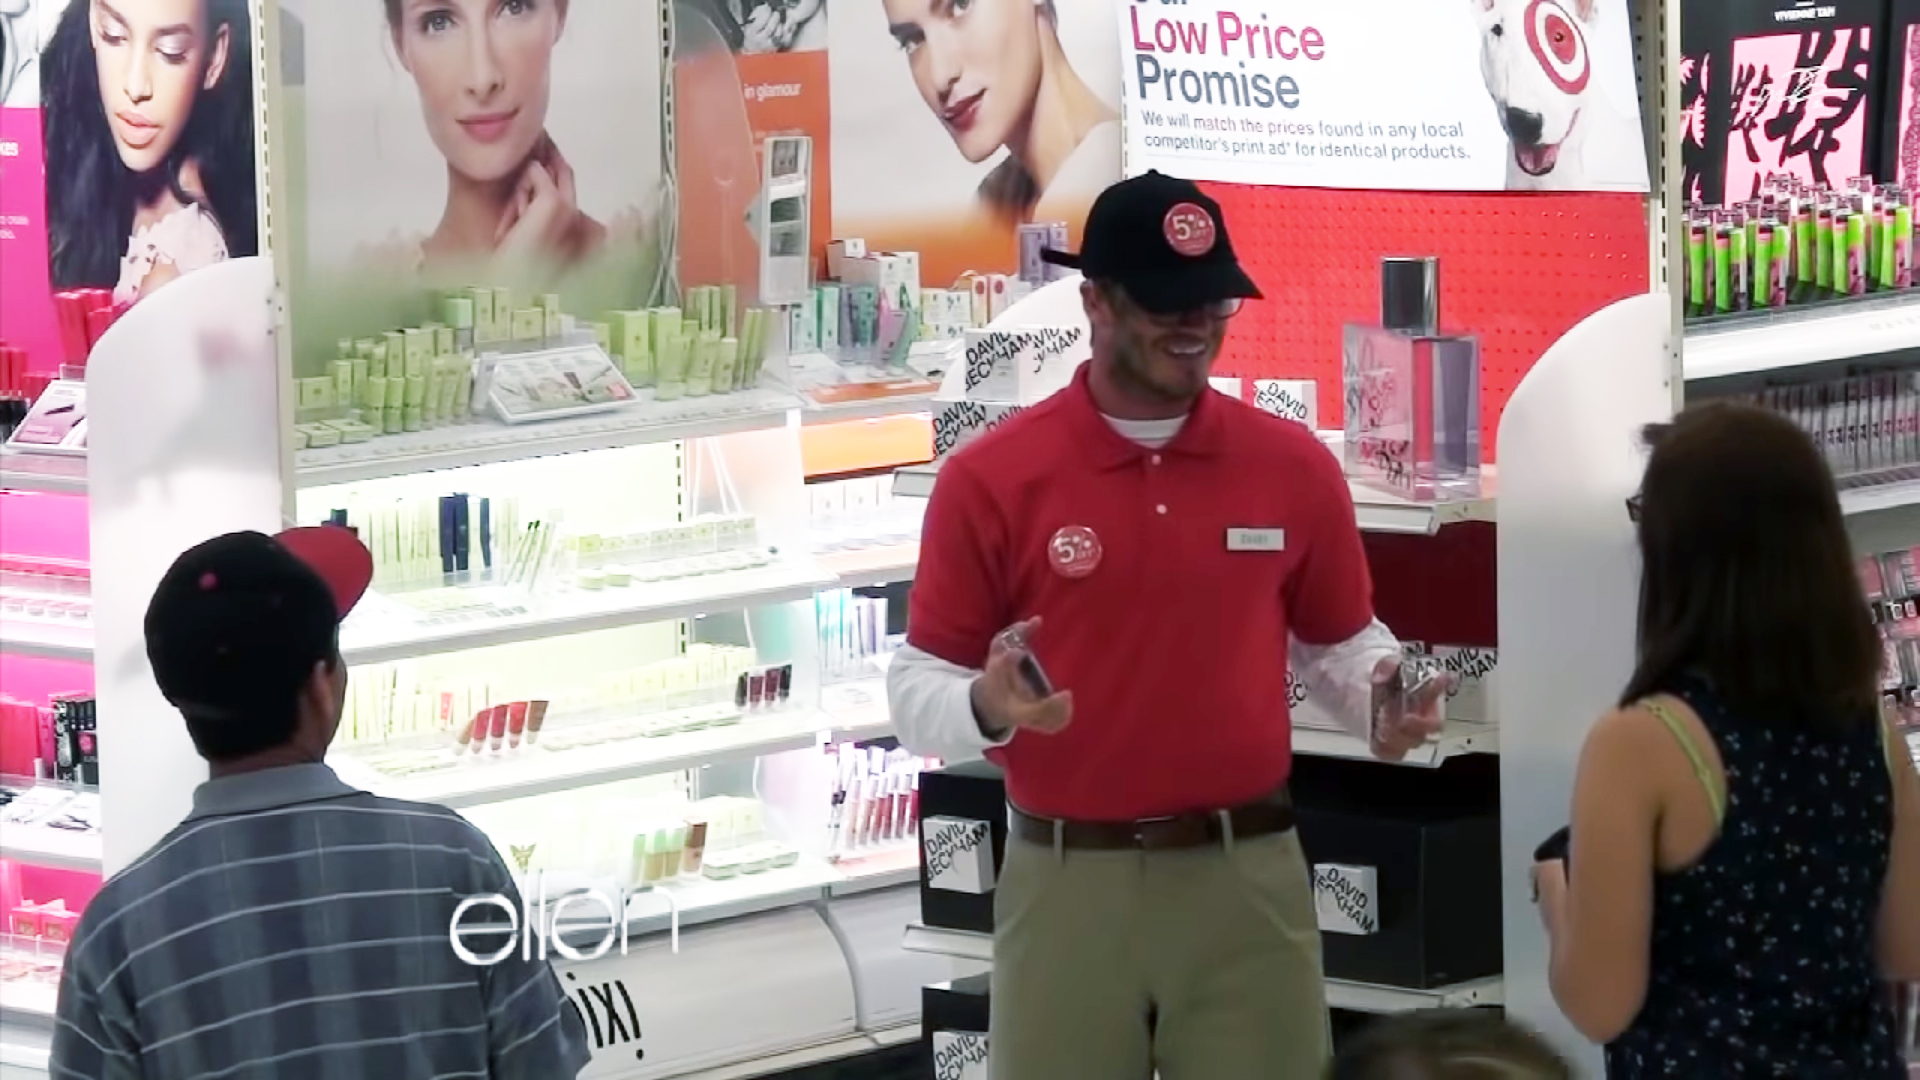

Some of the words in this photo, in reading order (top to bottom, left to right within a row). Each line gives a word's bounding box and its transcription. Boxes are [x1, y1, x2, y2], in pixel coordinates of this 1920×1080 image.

[1130, 5, 1208, 54] Low
[1216, 10, 1325, 61] Price
[1135, 53, 1300, 109] Promise
[1141, 110, 1163, 126] We
[1166, 113, 1190, 128] will
[1193, 116, 1237, 132] match
[1239, 118, 1264, 133] the
[1267, 121, 1315, 137] prices
[1319, 119, 1364, 137] found
[1368, 120, 1384, 137] in
[1388, 124, 1417, 141] any
[1421, 121, 1464, 137] local
[1144, 134, 1230, 154] competitor's
[1232, 140, 1267, 158] print
[1295, 142, 1315, 157] for
[1319, 143, 1387, 158] identical
[1391, 143, 1471, 162] products.
[1326, 868, 1368, 909] DAVID
